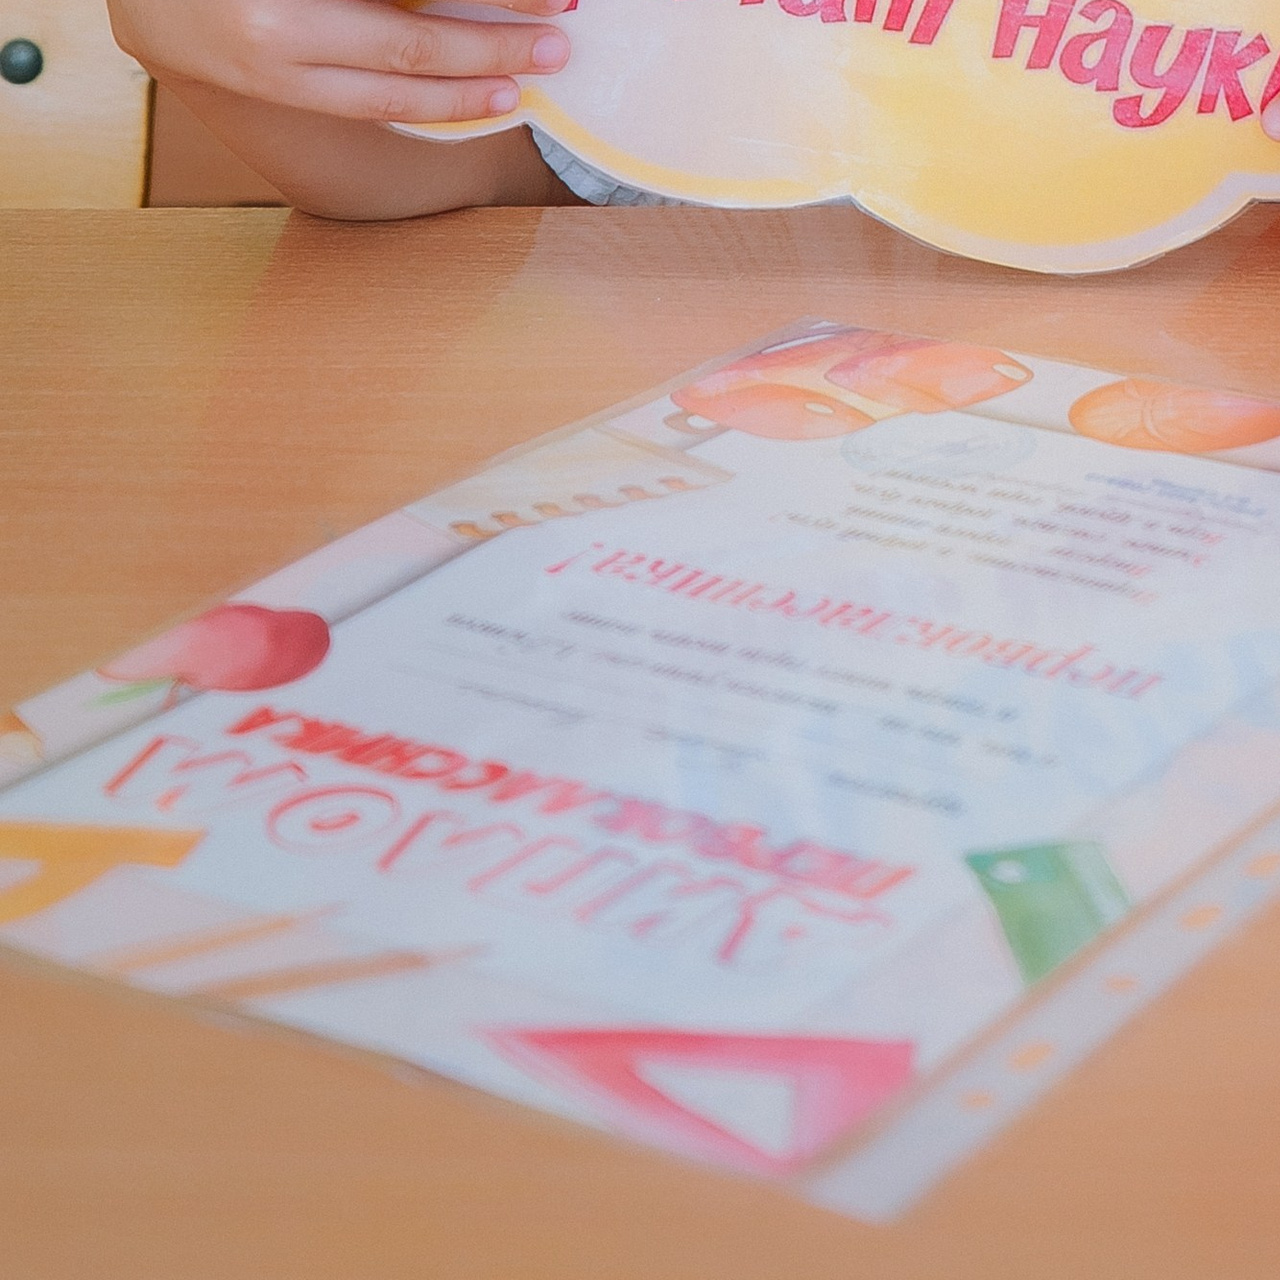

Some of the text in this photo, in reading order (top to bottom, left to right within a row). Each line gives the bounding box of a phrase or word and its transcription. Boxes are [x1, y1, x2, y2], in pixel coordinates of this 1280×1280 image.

[544, 540, 1166, 701] первоклассника!
[102, 733, 895, 964] ДИПЛОМ
[227, 705, 918, 900] ПЕРВОКЛАССНИКА
